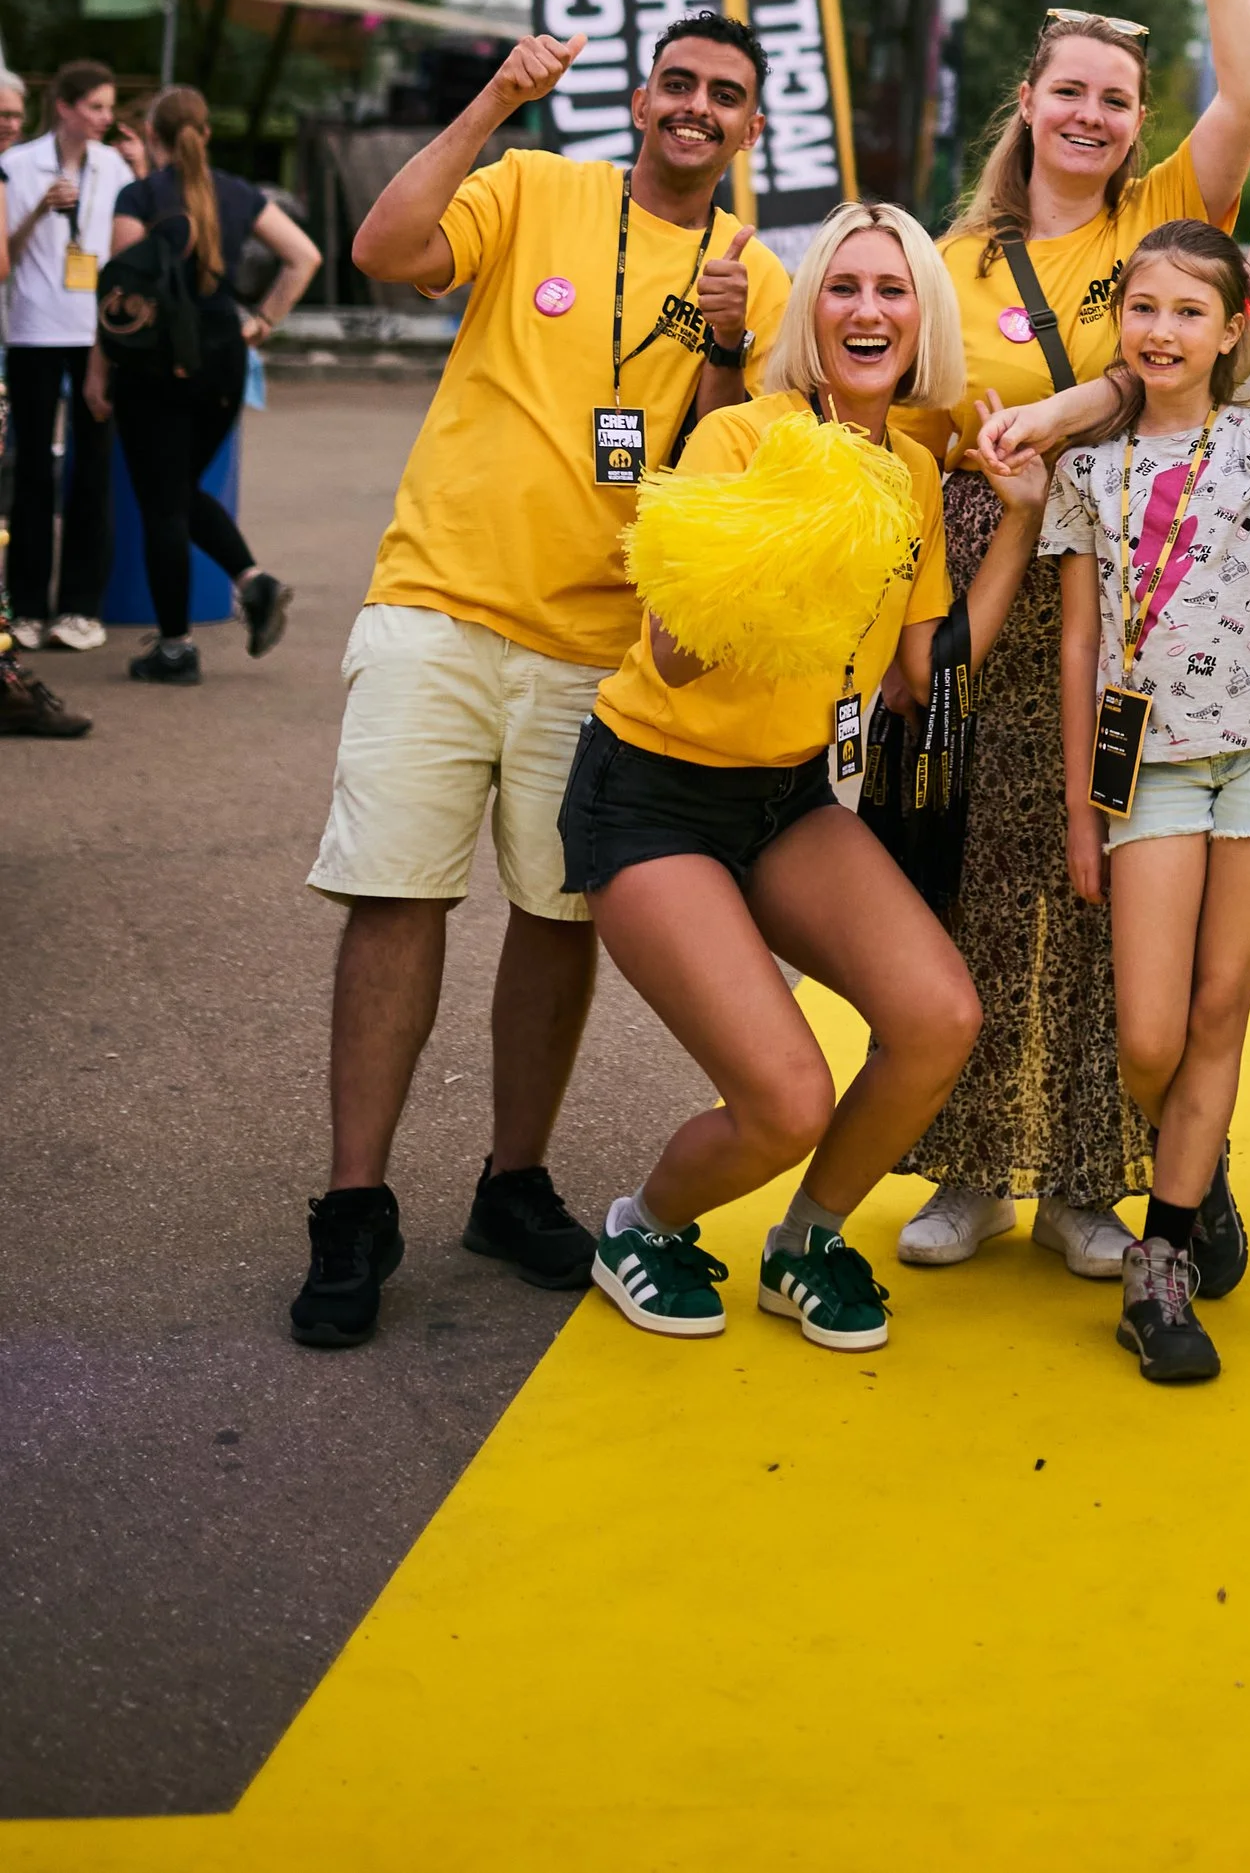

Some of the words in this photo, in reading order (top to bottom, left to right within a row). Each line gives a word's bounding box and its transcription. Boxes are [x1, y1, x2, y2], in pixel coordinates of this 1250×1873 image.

[662, 294, 713, 343] CRE
[600, 414, 638, 429] CREW
[1134, 456, 1152, 474] NOT
[1141, 460, 1160, 477] CUTE
[1218, 616, 1245, 635] BREAK
[1186, 663, 1215, 677] PWR
